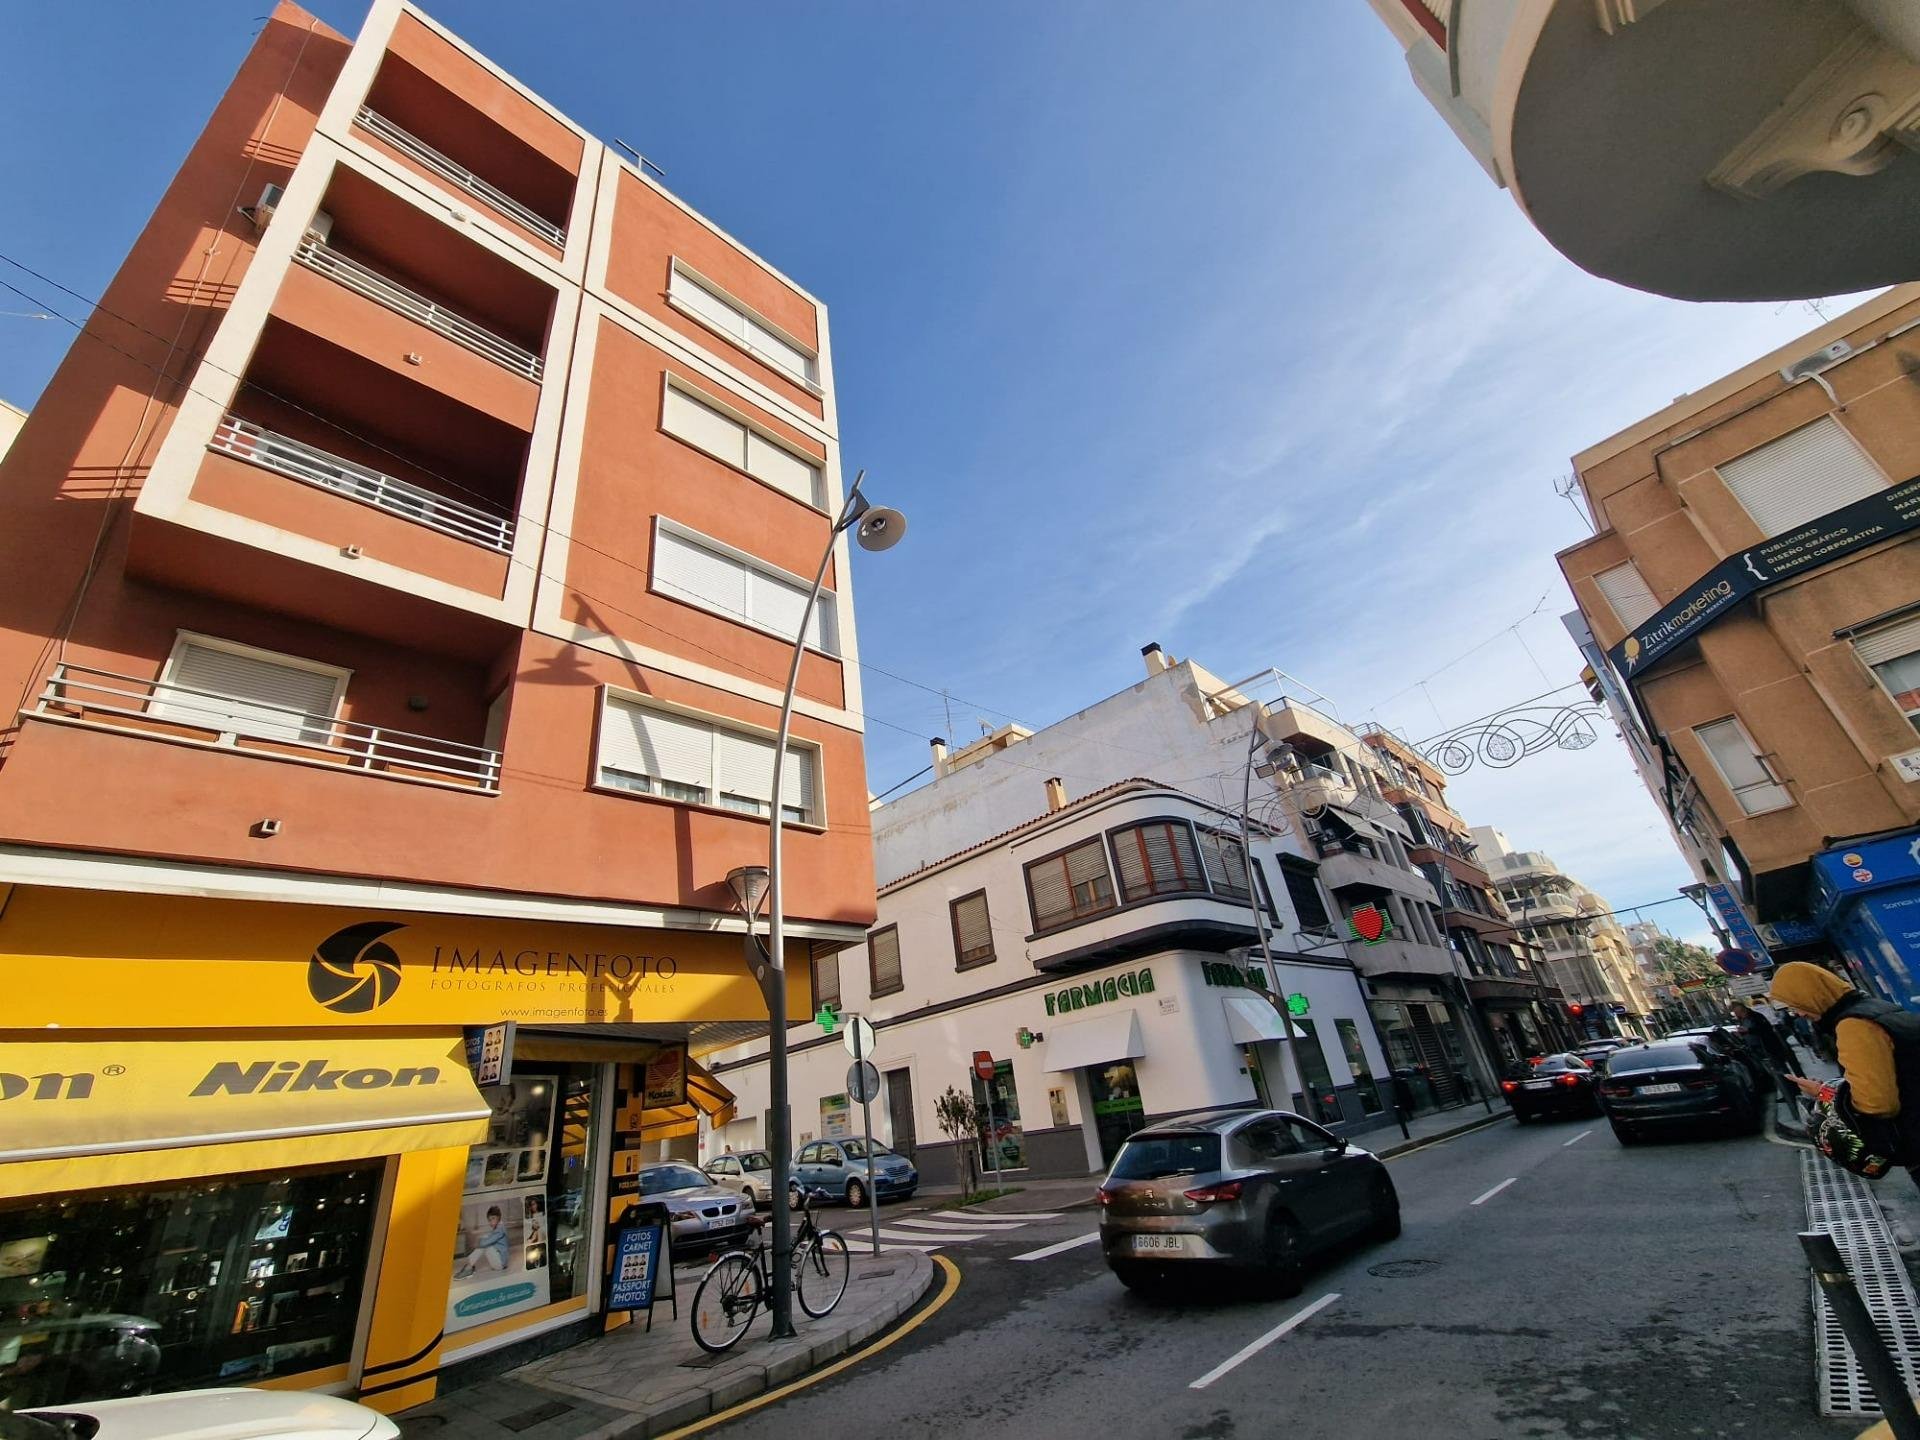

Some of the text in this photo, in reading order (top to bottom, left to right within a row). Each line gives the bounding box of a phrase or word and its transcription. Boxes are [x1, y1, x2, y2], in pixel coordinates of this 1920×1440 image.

[1760, 528, 1818, 555] PUBLICIDAD
[1767, 527, 1848, 564] DISEÑO GRÁFICO
[1773, 525, 1884, 573] IMAGEN CORPORATIVA
[1641, 580, 1731, 650] Zitrikmarketing
[432, 945, 677, 980] IMAGENFOTO
[559, 982, 675, 993] PROFESIONALES
[1044, 967, 1156, 1017] FARMACIA
[500, 1007, 608, 1018] www.imagenfoto.es
[188, 1060, 440, 1097] Nikon
[627, 1231, 652, 1242] FOTOS
[1163, 1236, 1180, 1249] JBL
[623, 1241, 653, 1253] CARNET
[613, 1280, 651, 1292] PASSPORT
[614, 1290, 646, 1303] PHOTOS
